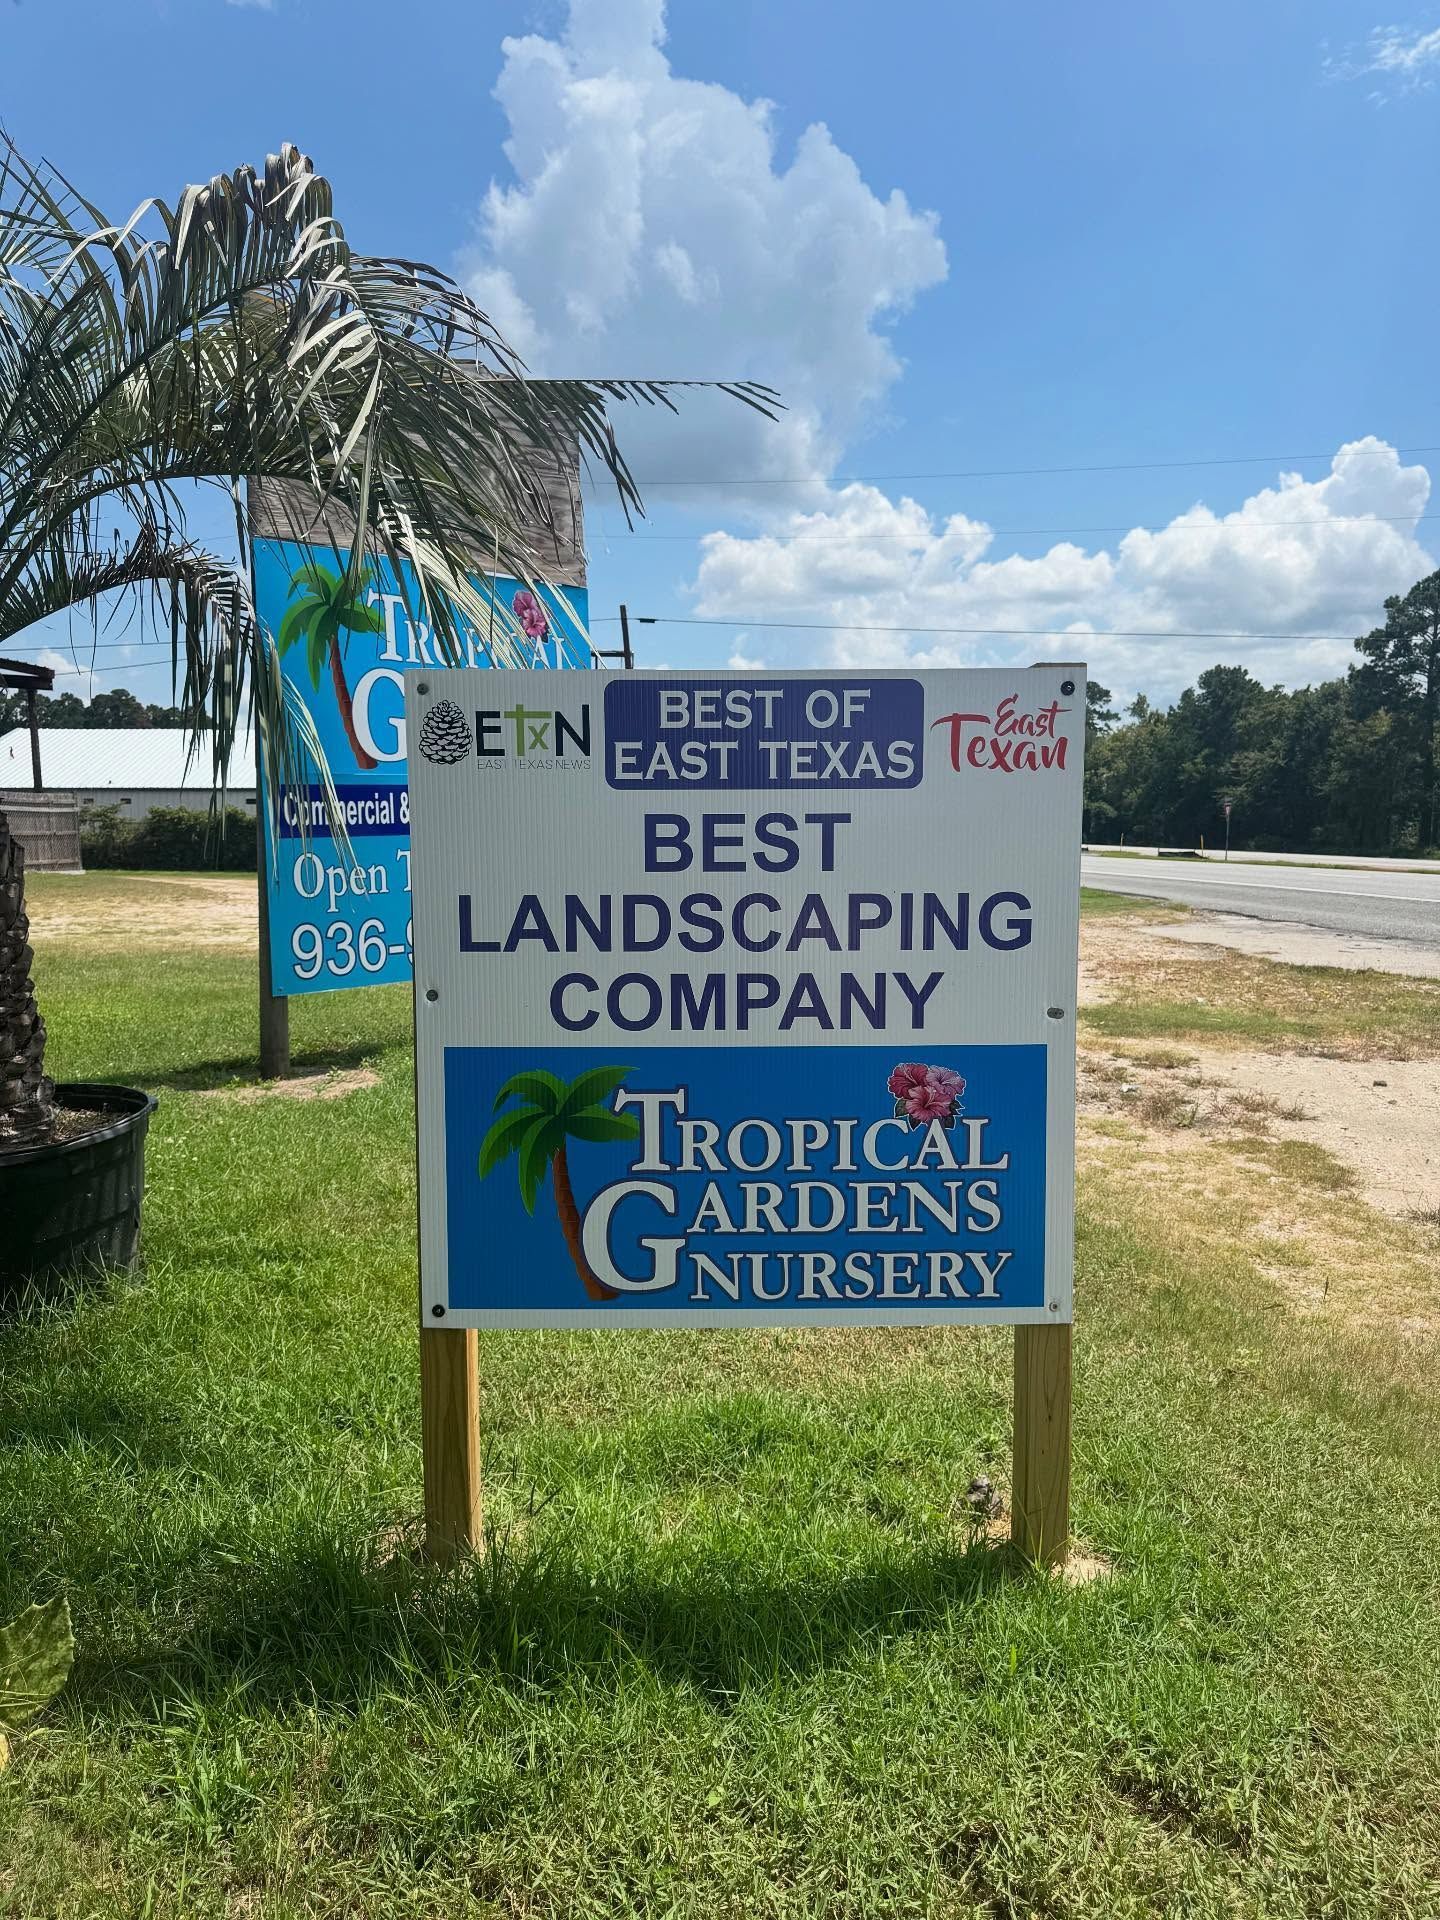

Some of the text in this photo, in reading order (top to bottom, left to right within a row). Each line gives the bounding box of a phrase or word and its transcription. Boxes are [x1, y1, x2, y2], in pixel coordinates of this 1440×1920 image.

[659, 688, 871, 728] BEST OF
[994, 693, 1072, 738] East
[477, 759, 591, 770] EAST TEXAS NEWS
[614, 740, 915, 780] EAST TEXAS
[930, 713, 1068, 773] Texan
[644, 812, 852, 873] BEST
[293, 852, 389, 913] Open
[458, 891, 1033, 953] LANDSCAPING
[549, 971, 945, 1032] COMPANY
[614, 1088, 1009, 1173] TROPICAL
[582, 1180, 1002, 1292] GARDENS
[689, 1251, 1013, 1301] NURSERY
